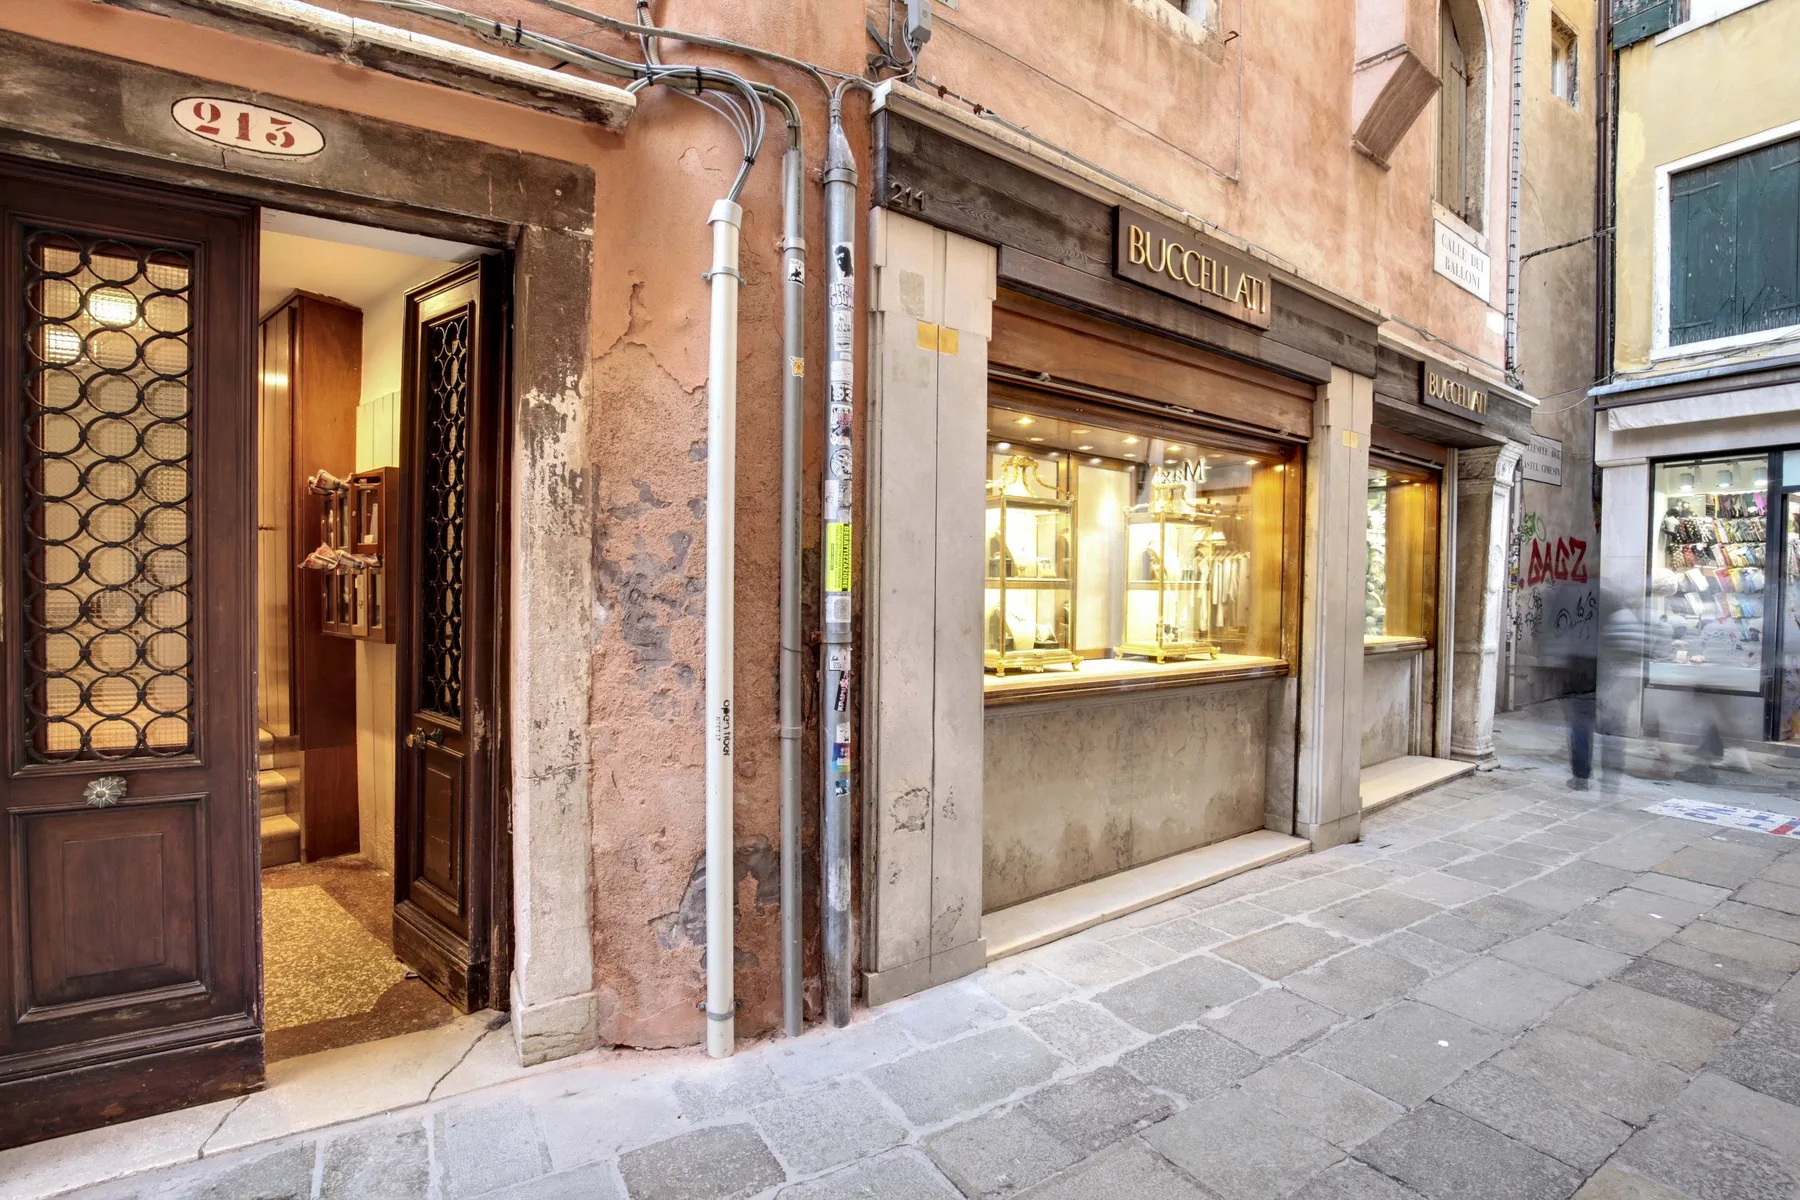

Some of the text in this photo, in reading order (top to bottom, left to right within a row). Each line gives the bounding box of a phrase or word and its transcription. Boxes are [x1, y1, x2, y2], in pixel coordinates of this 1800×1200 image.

[193, 101, 295, 149] 213
[891, 182, 925, 211] 214
[1128, 225, 1266, 313] BUCCELLATI
[1441, 233, 1484, 273] CALLE DEI
[1445, 256, 1480, 290] BALLONI
[1429, 372, 1487, 416] BUCCELLATI
[842, 525, 850, 589] DERATTIZZAZIONE
[721, 699, 731, 730] open
